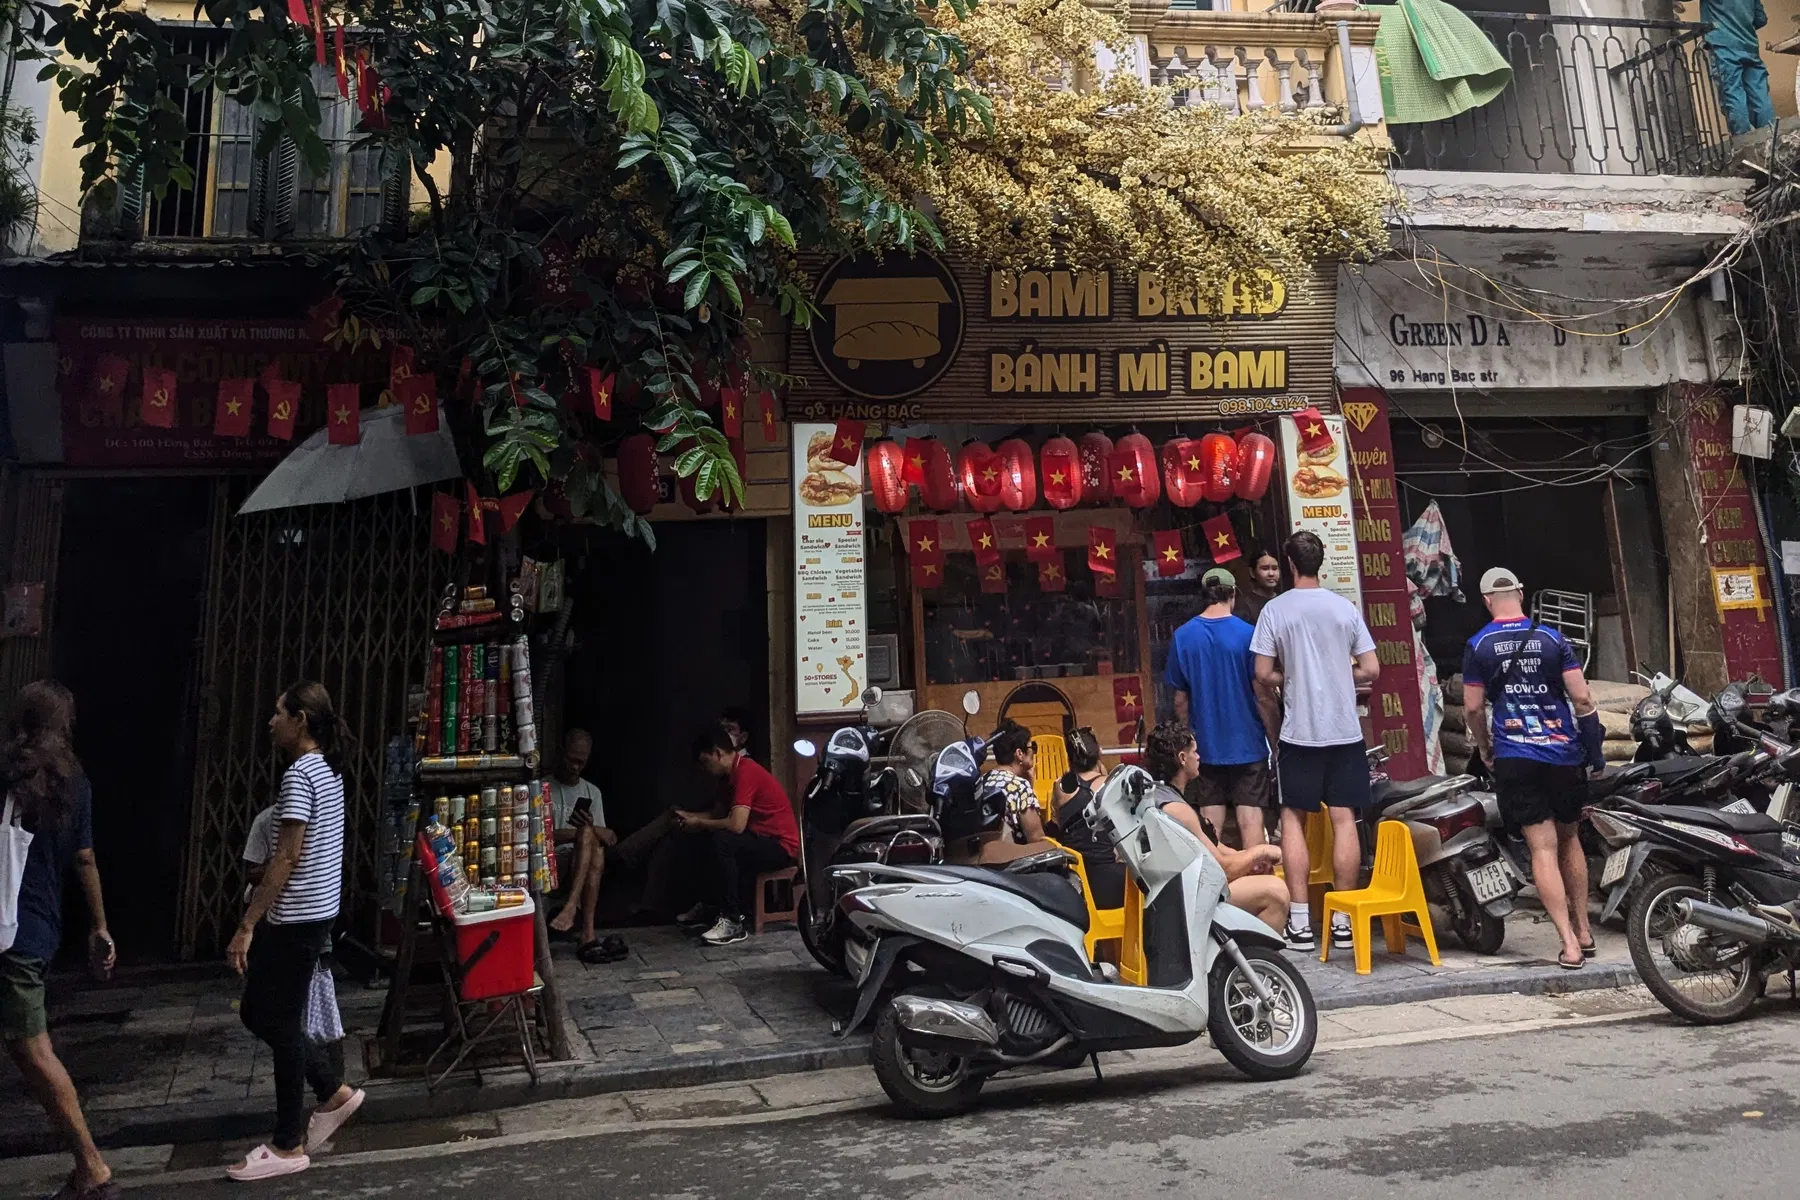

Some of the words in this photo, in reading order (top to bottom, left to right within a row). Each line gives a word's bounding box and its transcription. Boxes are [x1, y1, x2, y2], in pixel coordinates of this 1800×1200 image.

[991, 271, 1109, 317] BAMI
[1389, 314, 1464, 348] GREEN
[991, 345, 1096, 392] BÁNH
[1118, 344, 1167, 392] MÌ
[1190, 351, 1285, 390] BAMI
[1390, 369, 1405, 382] 96
[1413, 369, 1446, 385] Hang
[1452, 370, 1476, 382] Bac
[1480, 370, 1499, 383] str
[804, 402, 826, 419] 98
[1219, 396, 1308, 415] 098.104.3144
[808, 513, 853, 528] MENU
[1302, 504, 1342, 519] MENU
[1363, 552, 1391, 580] BẠC
[1368, 602, 1397, 627] KIM
[1504, 683, 1548, 694] BOWLO
